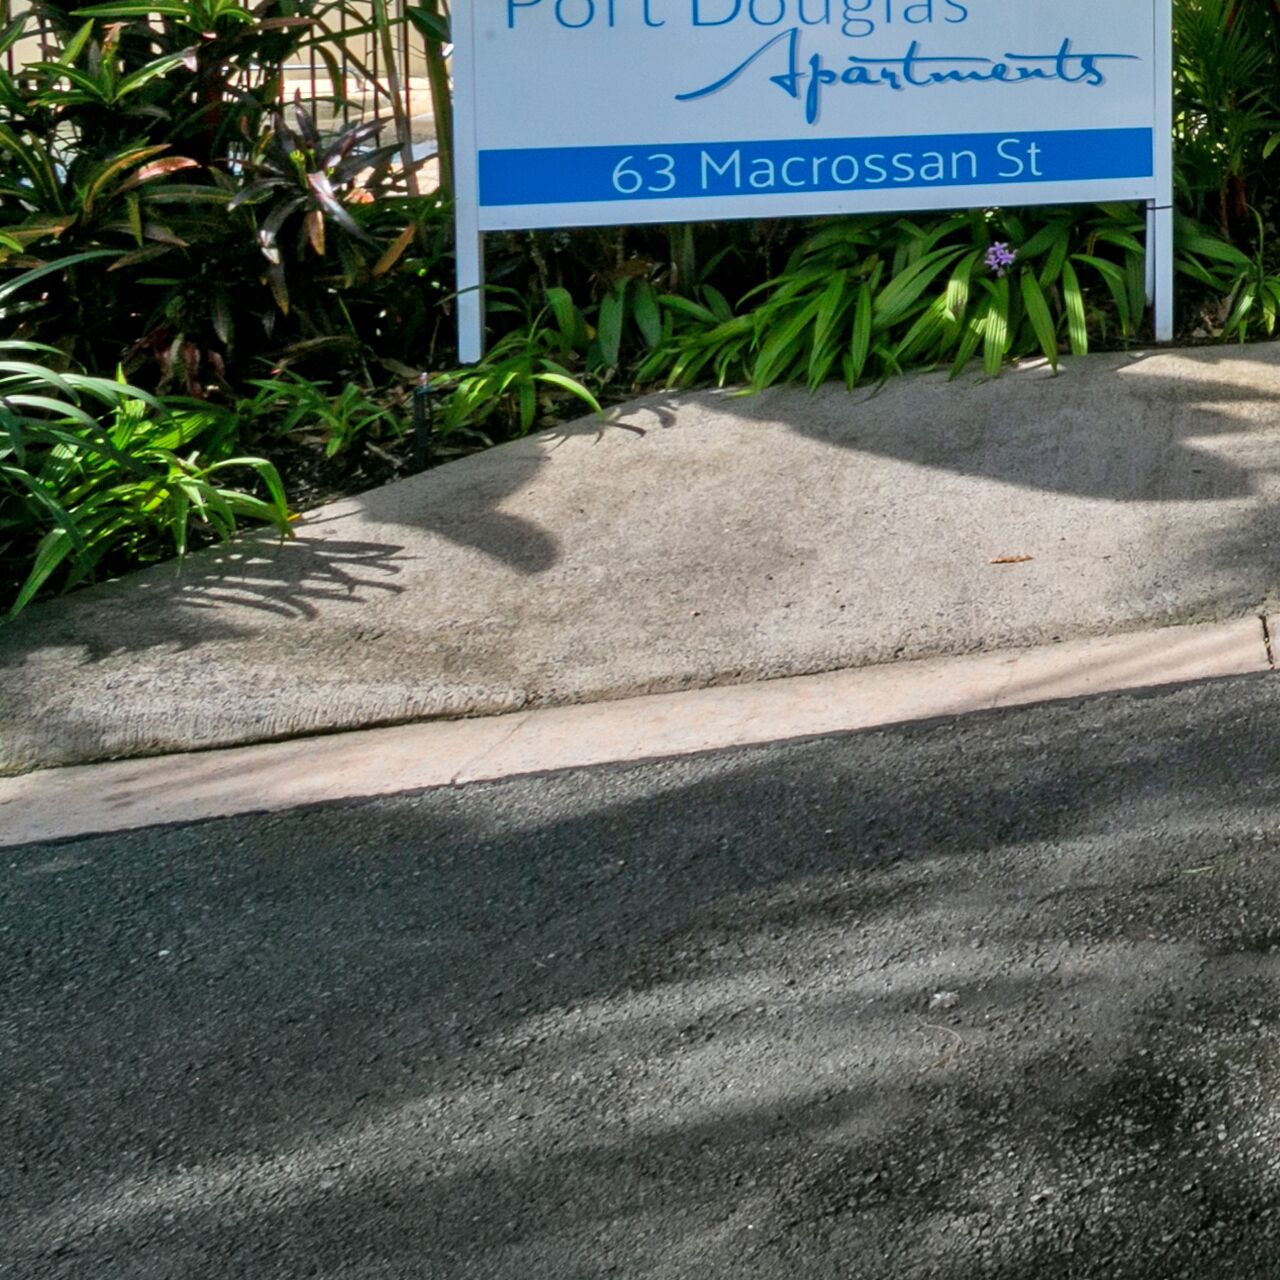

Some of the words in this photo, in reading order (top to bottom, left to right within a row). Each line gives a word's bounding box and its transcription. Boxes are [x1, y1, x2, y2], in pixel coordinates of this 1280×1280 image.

[675, 27, 1143, 124] Apartments
[610, 152, 677, 194] 63
[700, 141, 978, 190] Macrossan
[995, 137, 1044, 178] St
